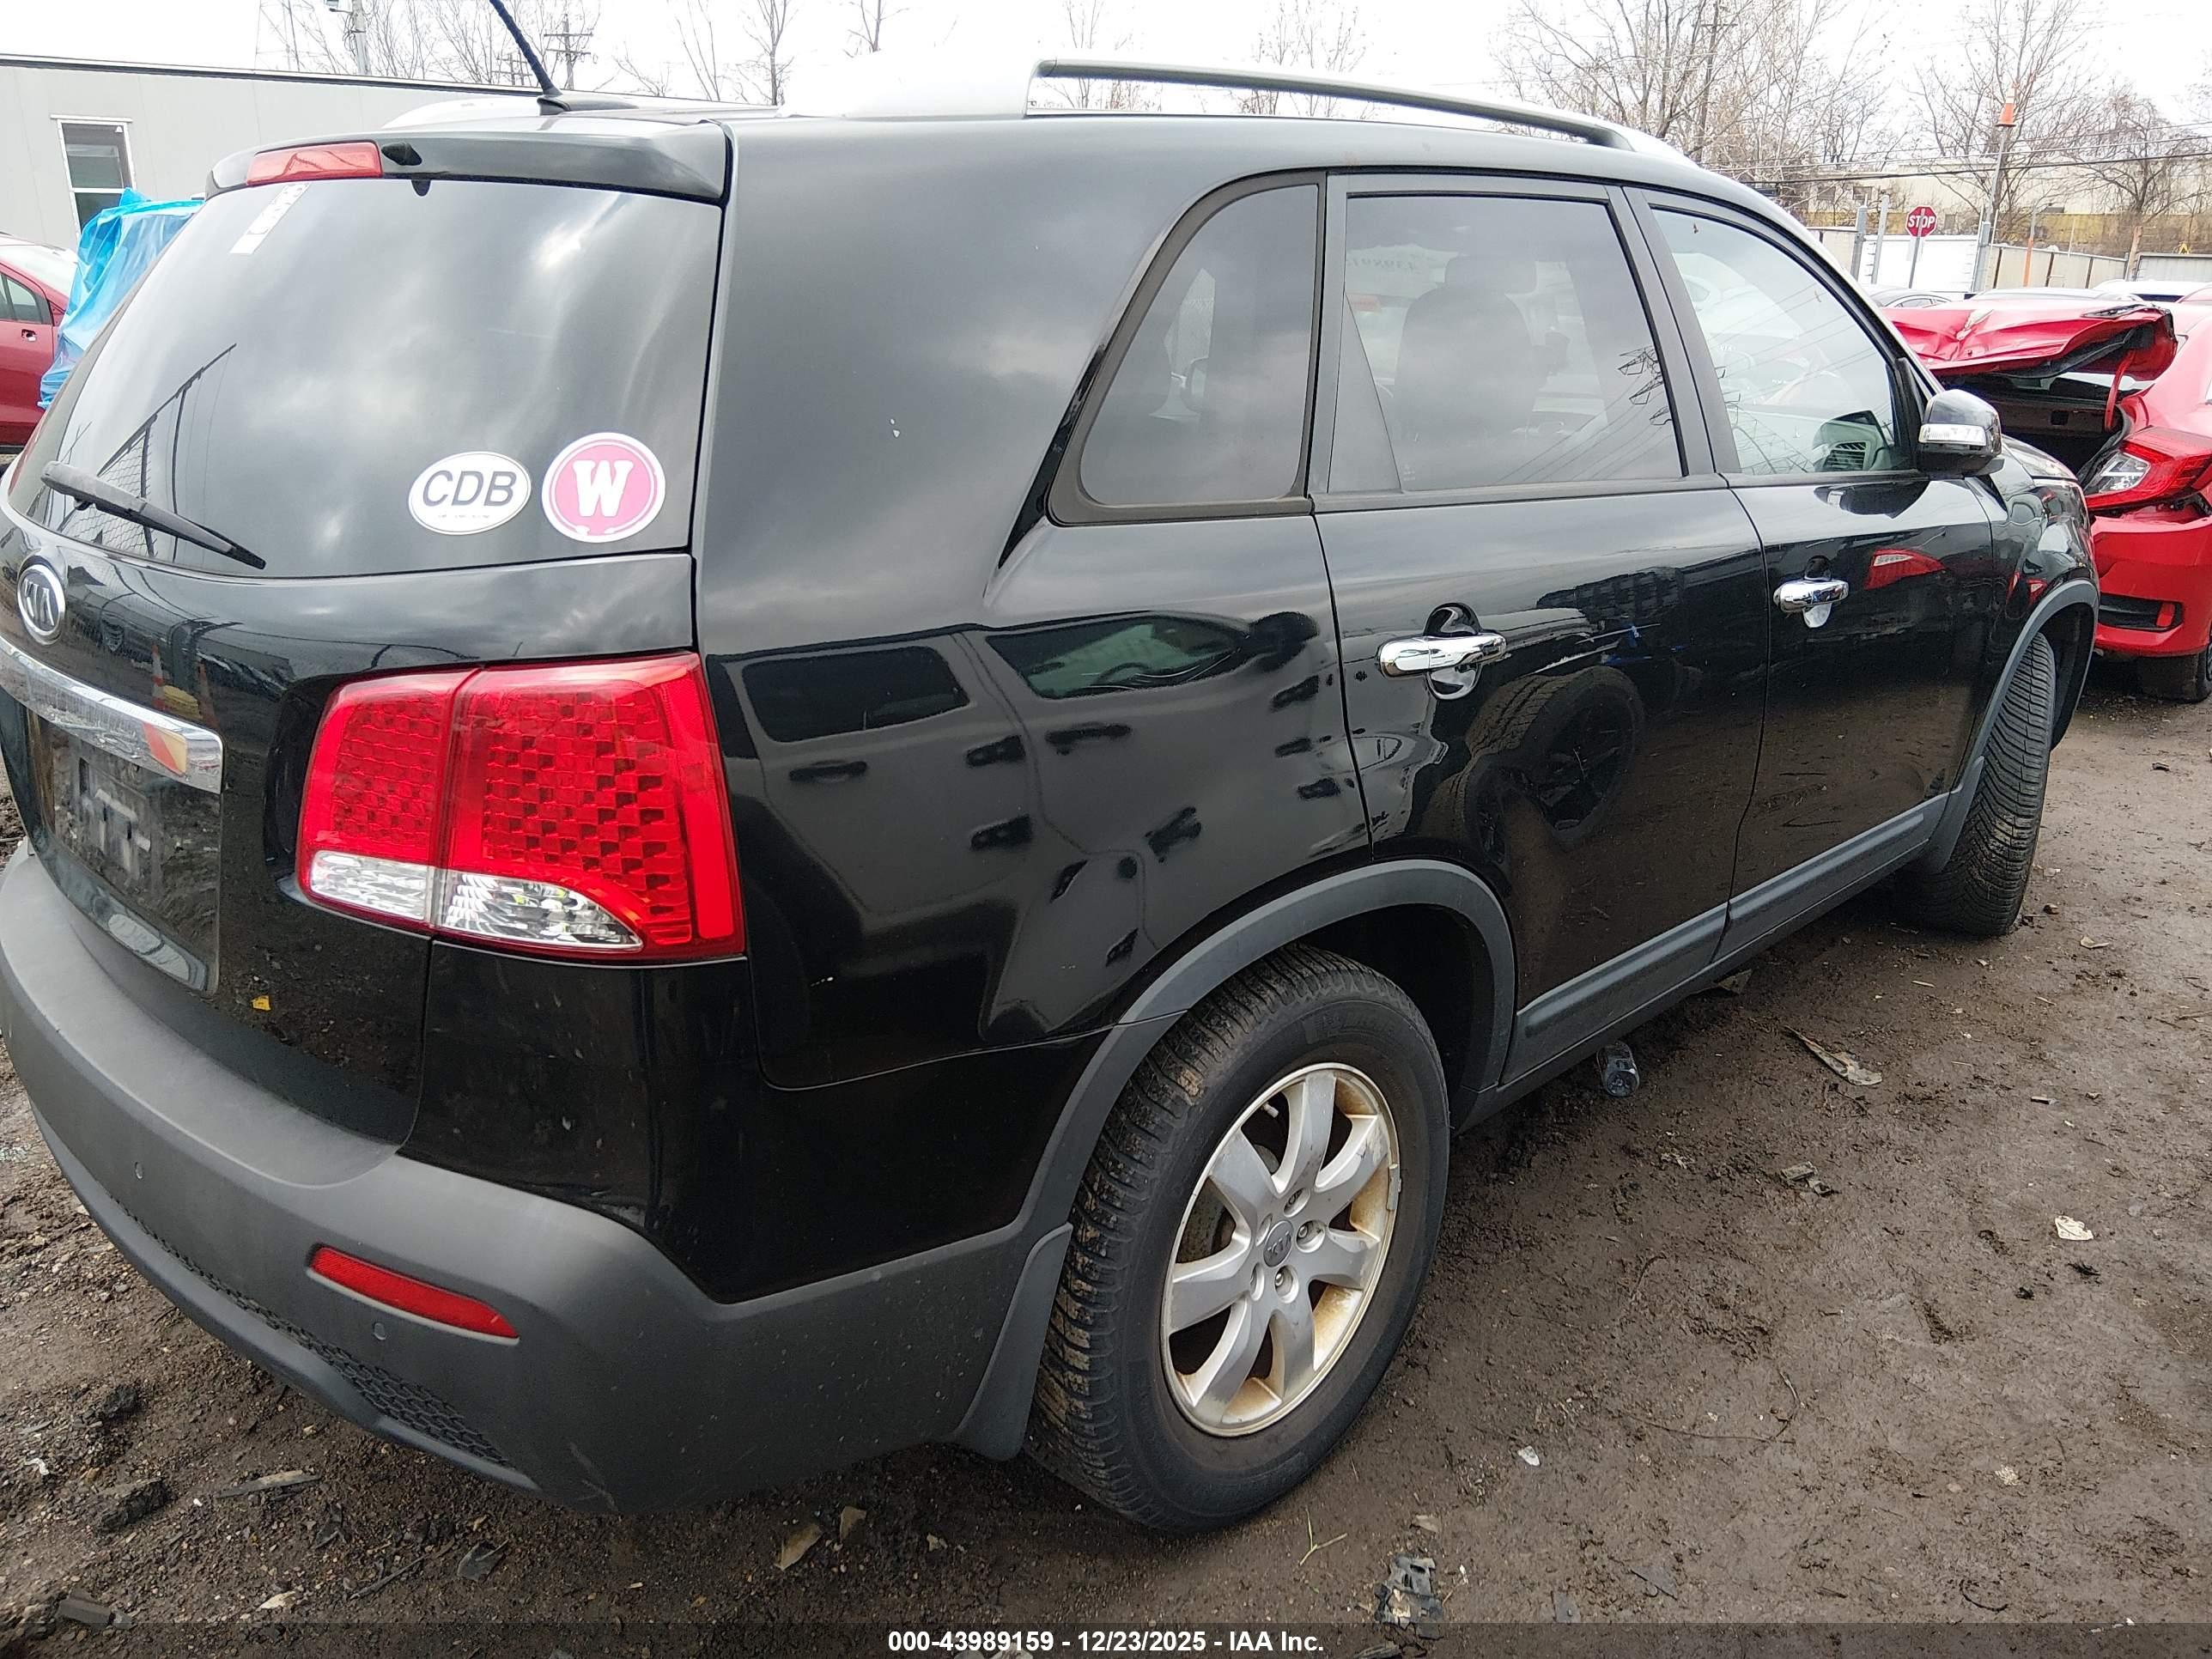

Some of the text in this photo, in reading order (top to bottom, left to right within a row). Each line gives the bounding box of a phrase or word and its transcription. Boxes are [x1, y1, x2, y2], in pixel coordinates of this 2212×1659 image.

[1908, 215, 1936, 228] STOP
[422, 470, 517, 507] CDB
[572, 459, 635, 518] W
